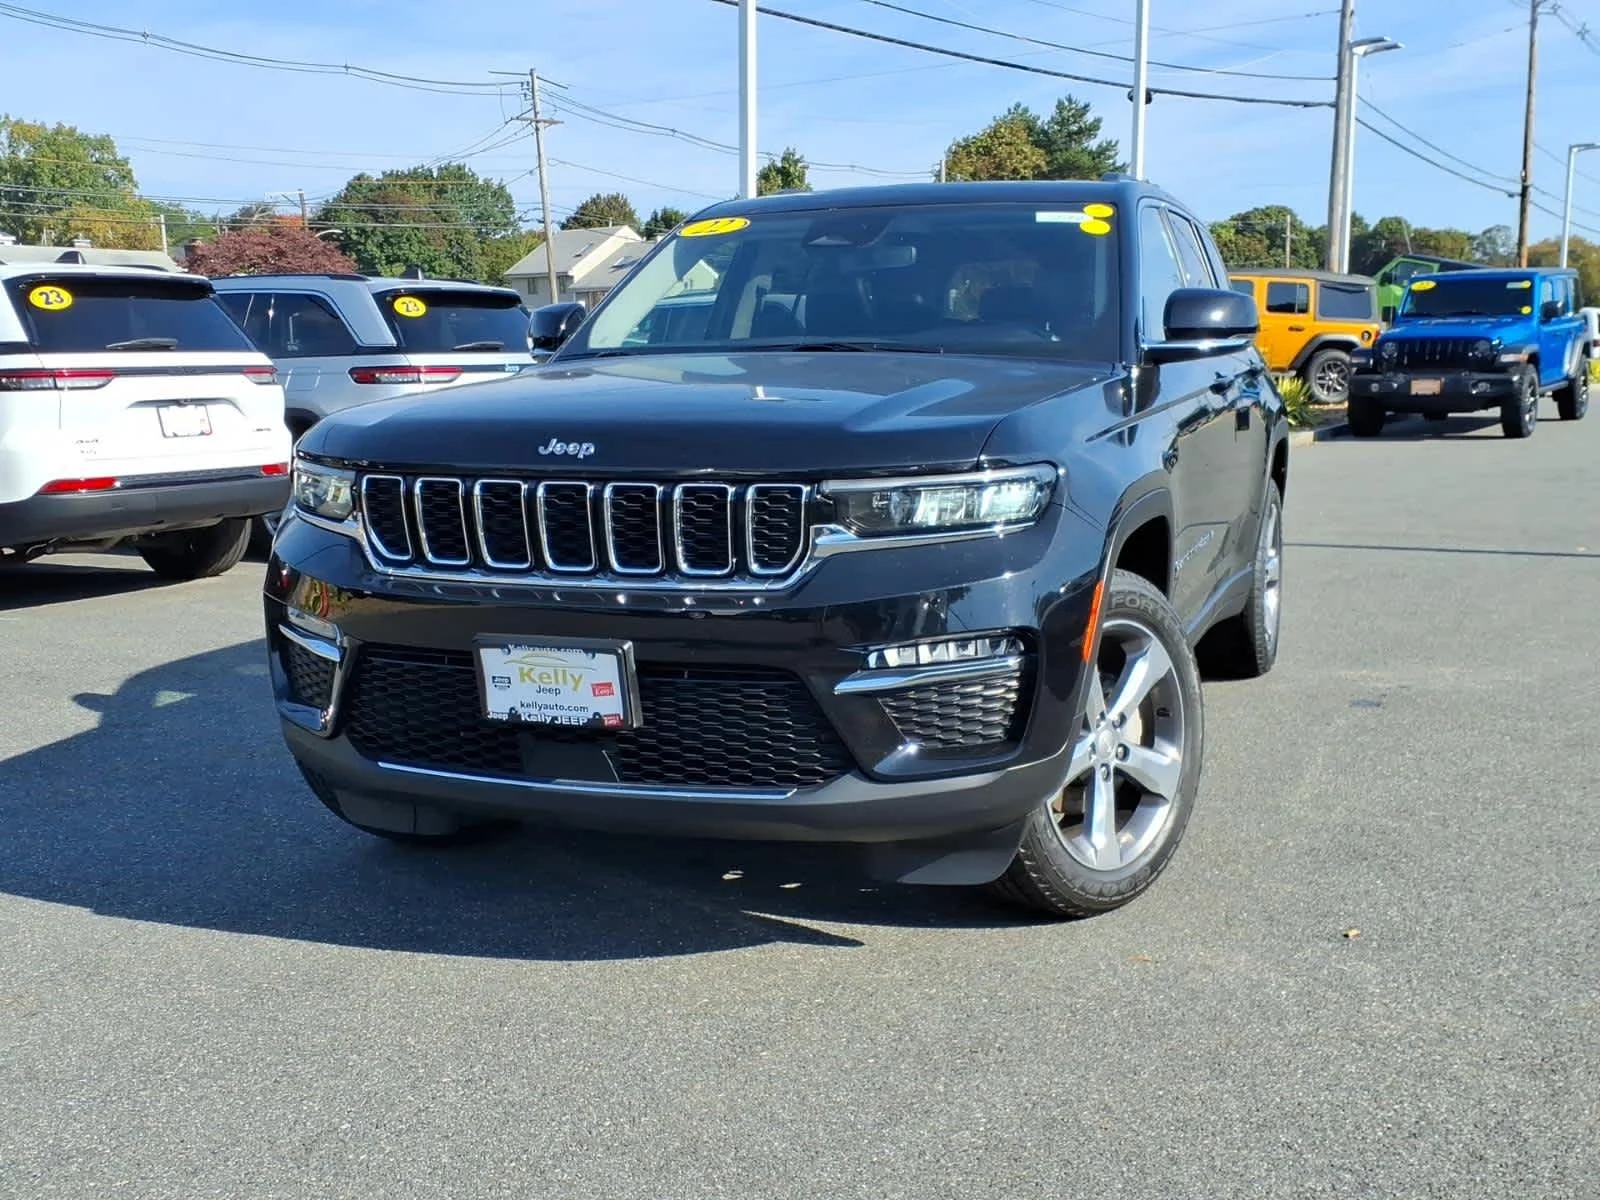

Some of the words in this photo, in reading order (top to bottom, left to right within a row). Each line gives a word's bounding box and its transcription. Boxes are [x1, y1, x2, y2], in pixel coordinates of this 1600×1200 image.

[38, 289, 64, 305] 23
[400, 300, 420, 313] 23
[538, 438, 595, 459] Jeep
[518, 667, 583, 692] Kelly
[535, 685, 561, 696] Jeep
[520, 700, 589, 713] kellyauto.com
[520, 712, 552, 724] Kelly
[554, 715, 588, 726] JEEP
